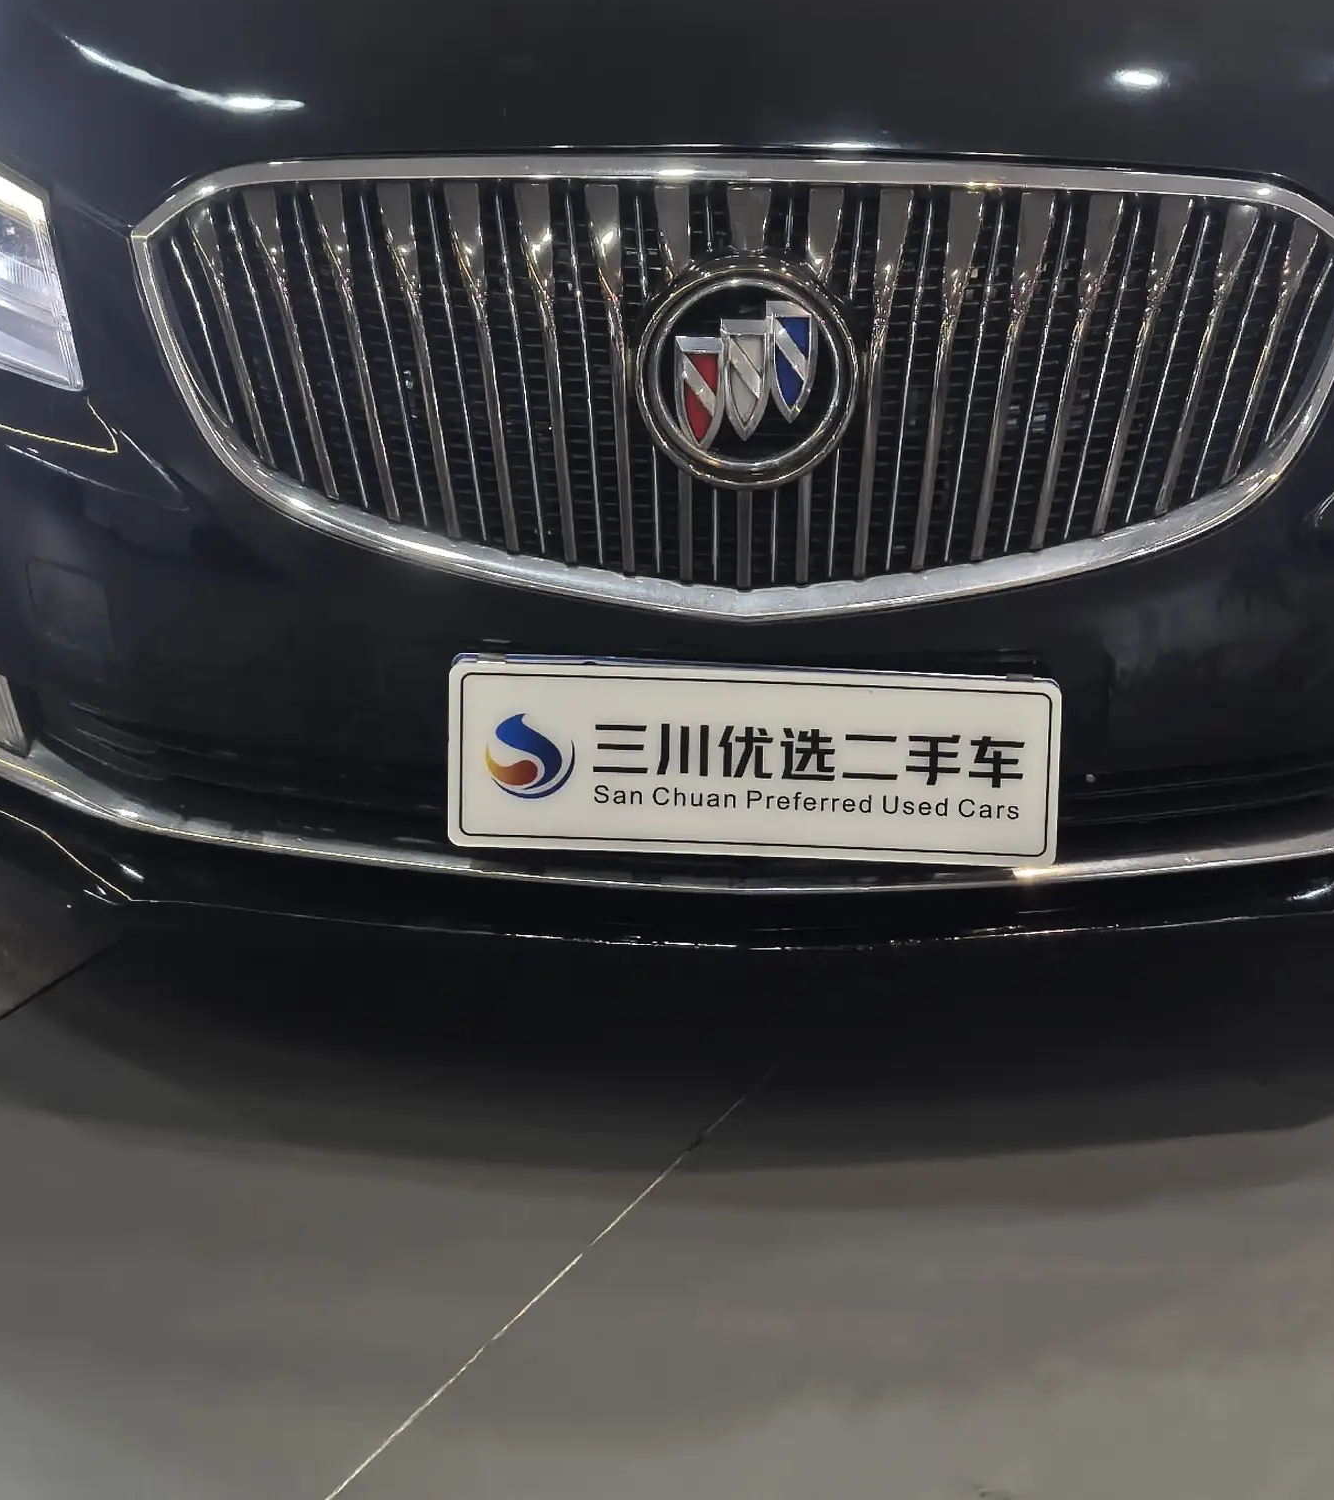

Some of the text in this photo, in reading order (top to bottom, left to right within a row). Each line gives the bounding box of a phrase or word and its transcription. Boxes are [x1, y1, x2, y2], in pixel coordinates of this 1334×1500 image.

[593, 723, 1025, 789] 三川优选二手车
[593, 784, 1019, 820] San Chuan Preferred Used Cars
